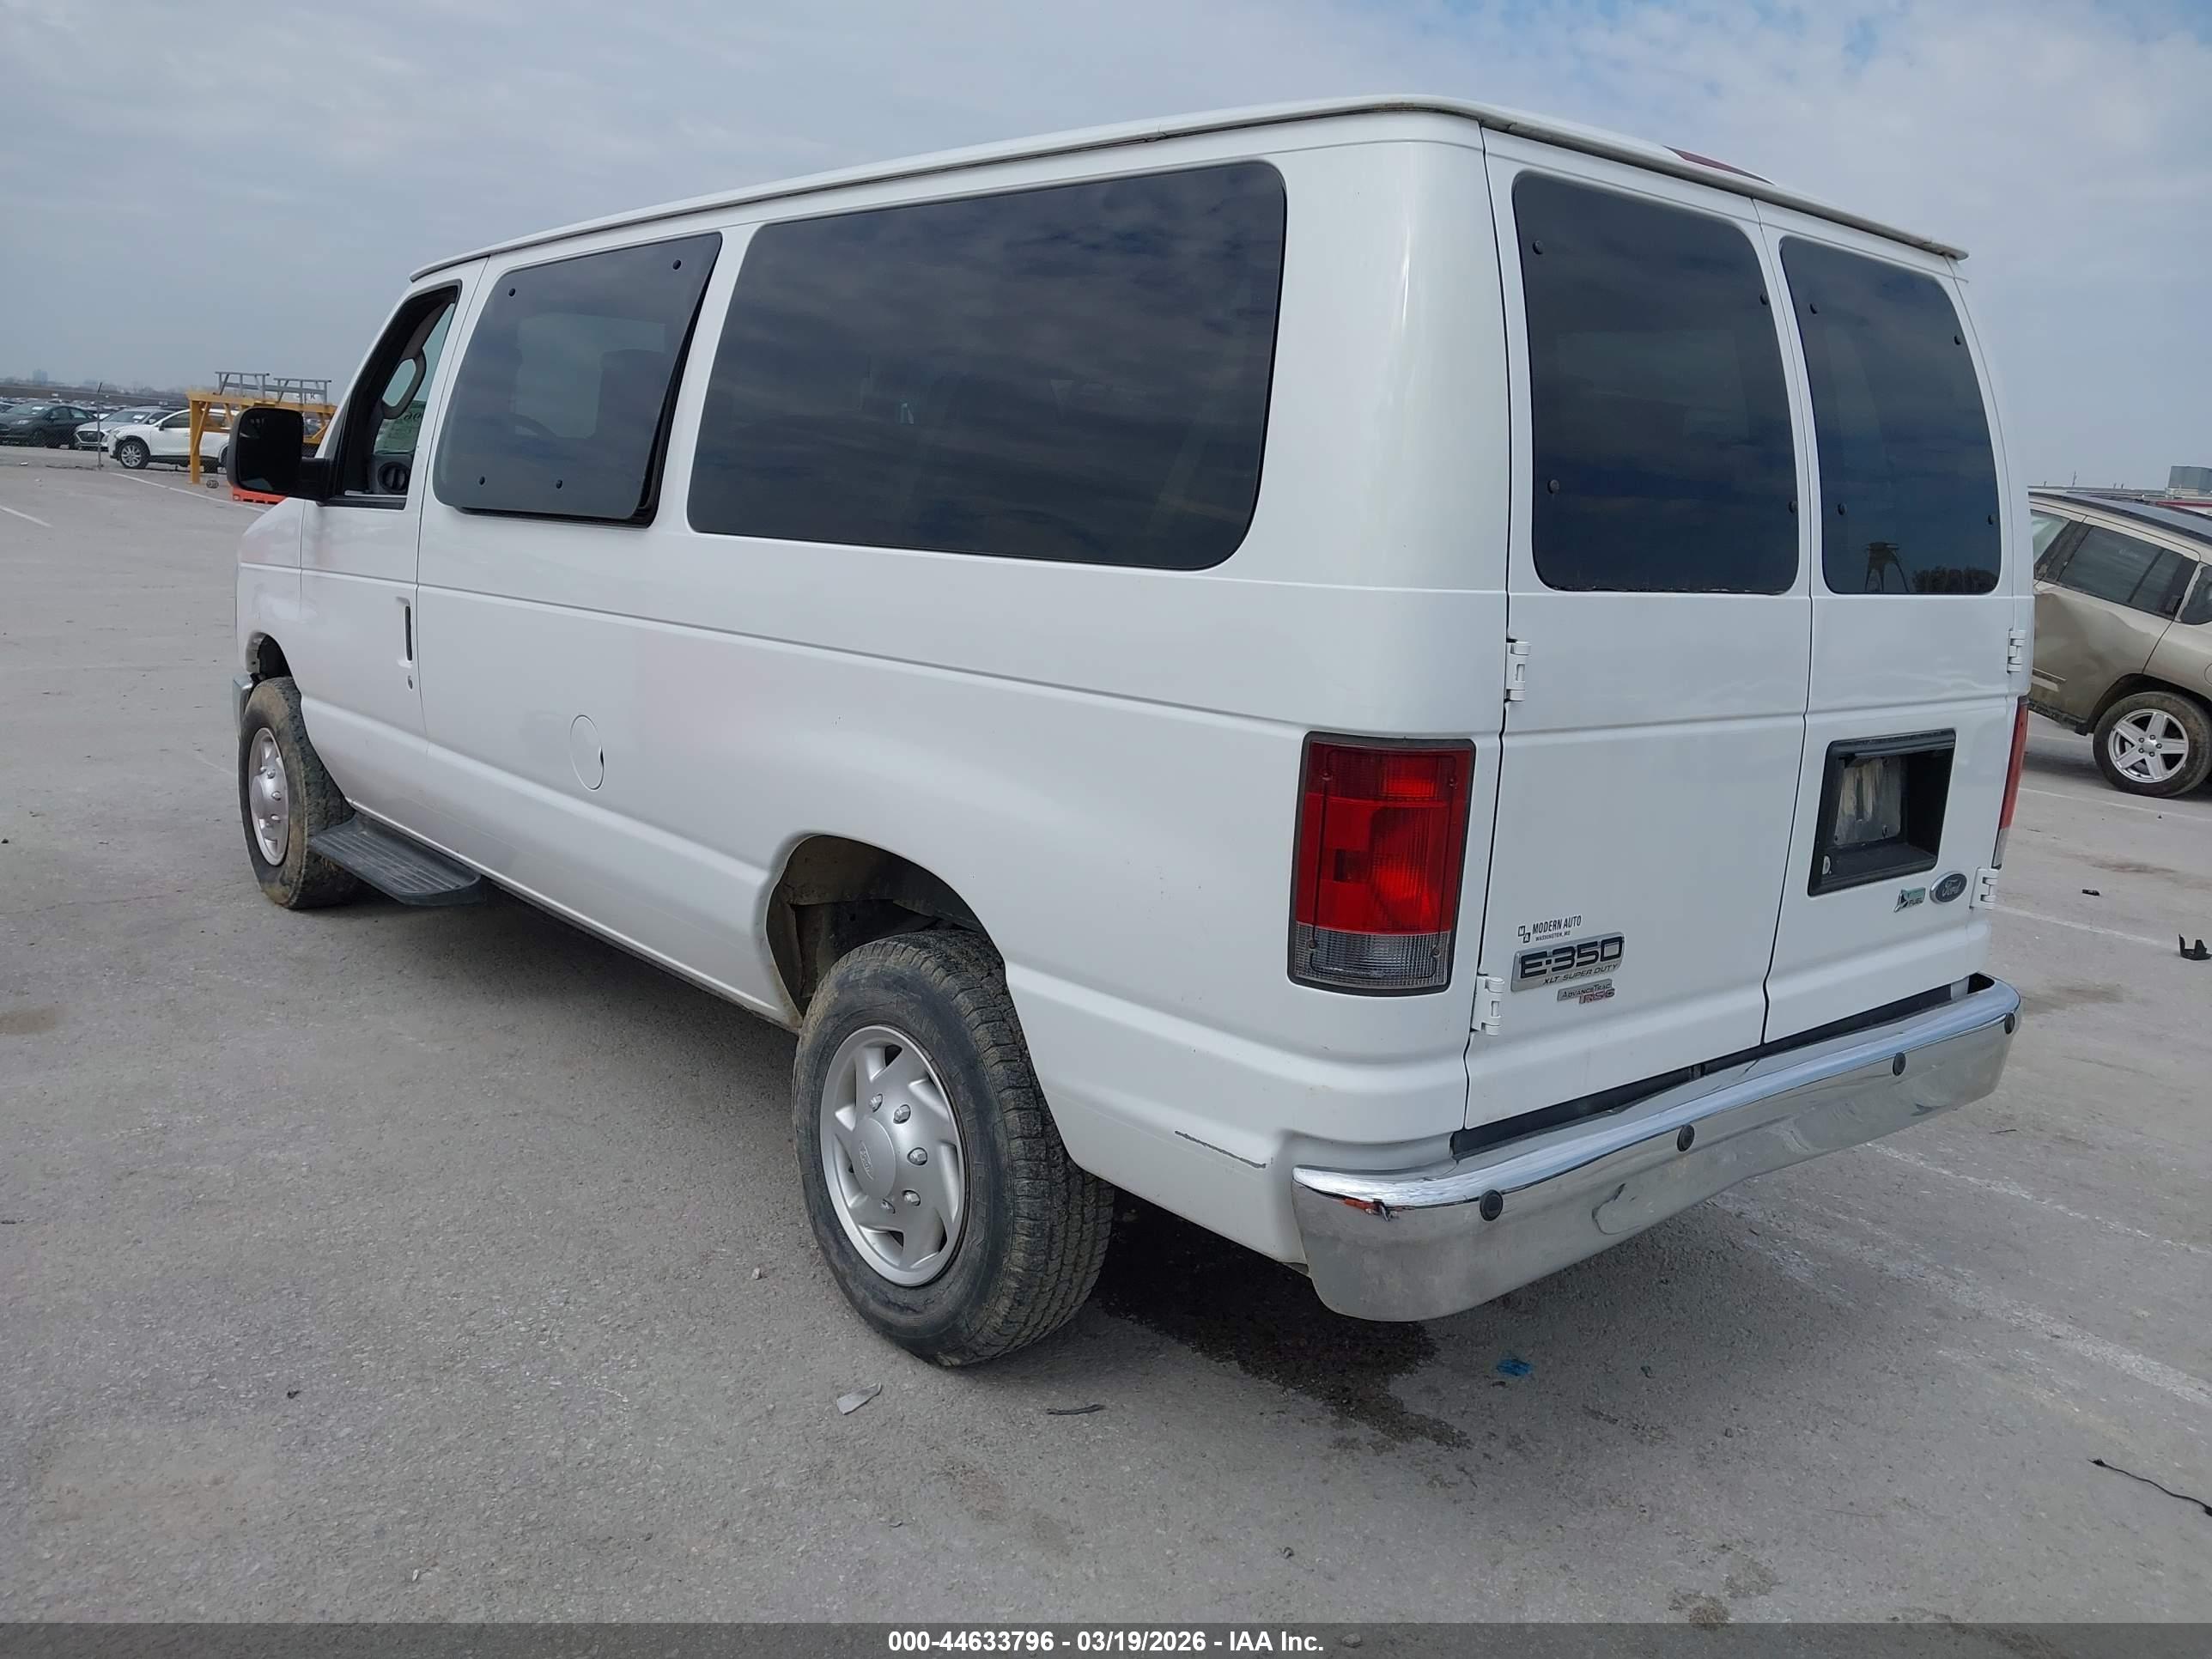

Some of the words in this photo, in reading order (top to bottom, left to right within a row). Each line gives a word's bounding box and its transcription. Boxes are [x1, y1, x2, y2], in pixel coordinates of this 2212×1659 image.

[1532, 918, 1563, 935] MODERN
[1563, 915, 1582, 929] AUTO
[1520, 935, 1623, 979] E-350
[1542, 975, 1560, 986] XLT
[1562, 968, 1593, 981] SUPER
[1594, 963, 1618, 975] DUTY
